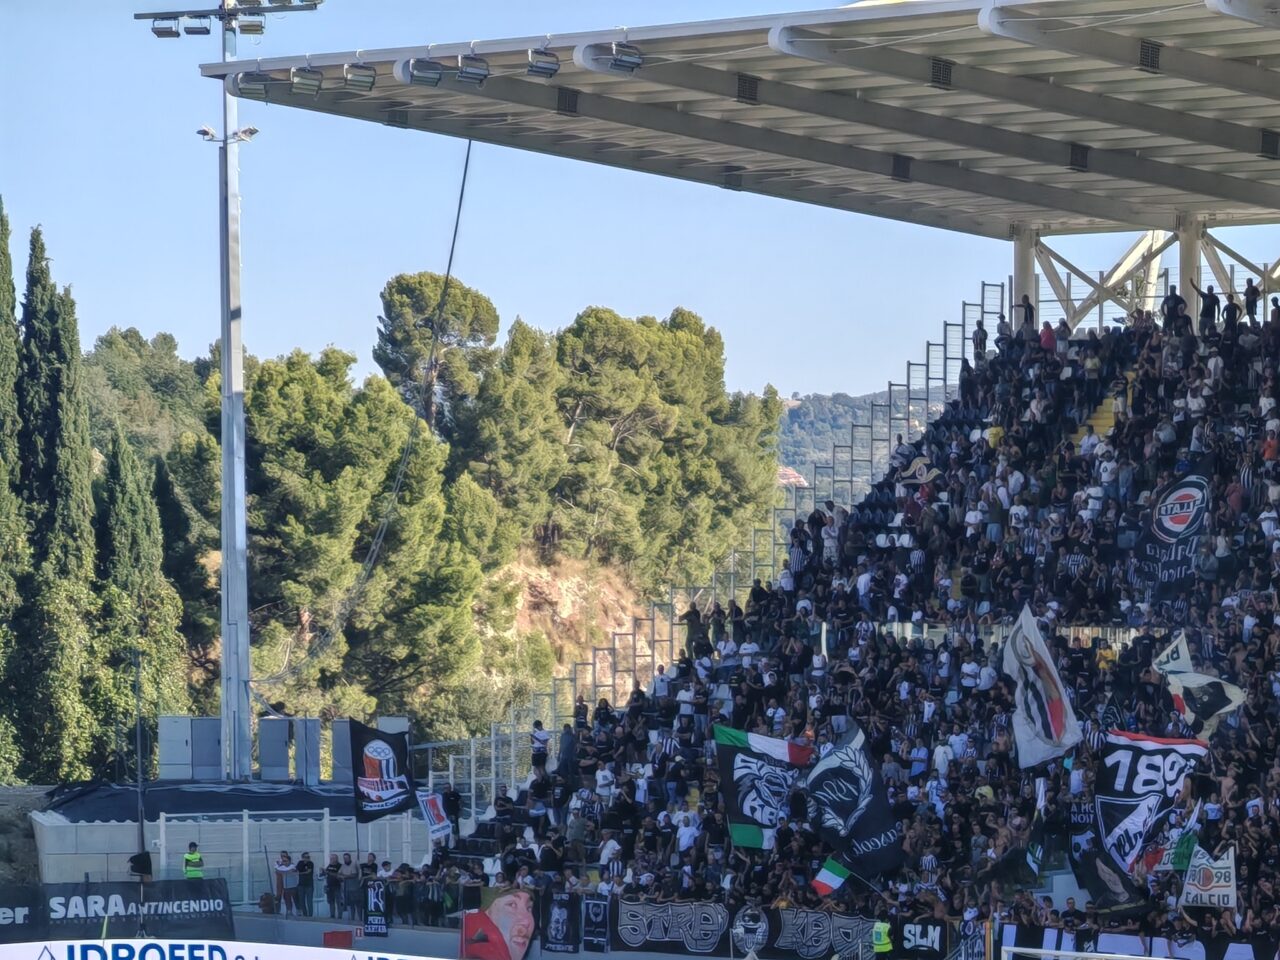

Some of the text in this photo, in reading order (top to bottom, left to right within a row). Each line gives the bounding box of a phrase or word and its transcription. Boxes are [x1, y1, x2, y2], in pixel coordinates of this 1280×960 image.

[50, 893, 223, 918] SARA ANTINCENDIO
[1185, 894, 1230, 905] CALCIO
[903, 923, 939, 950] SLM
